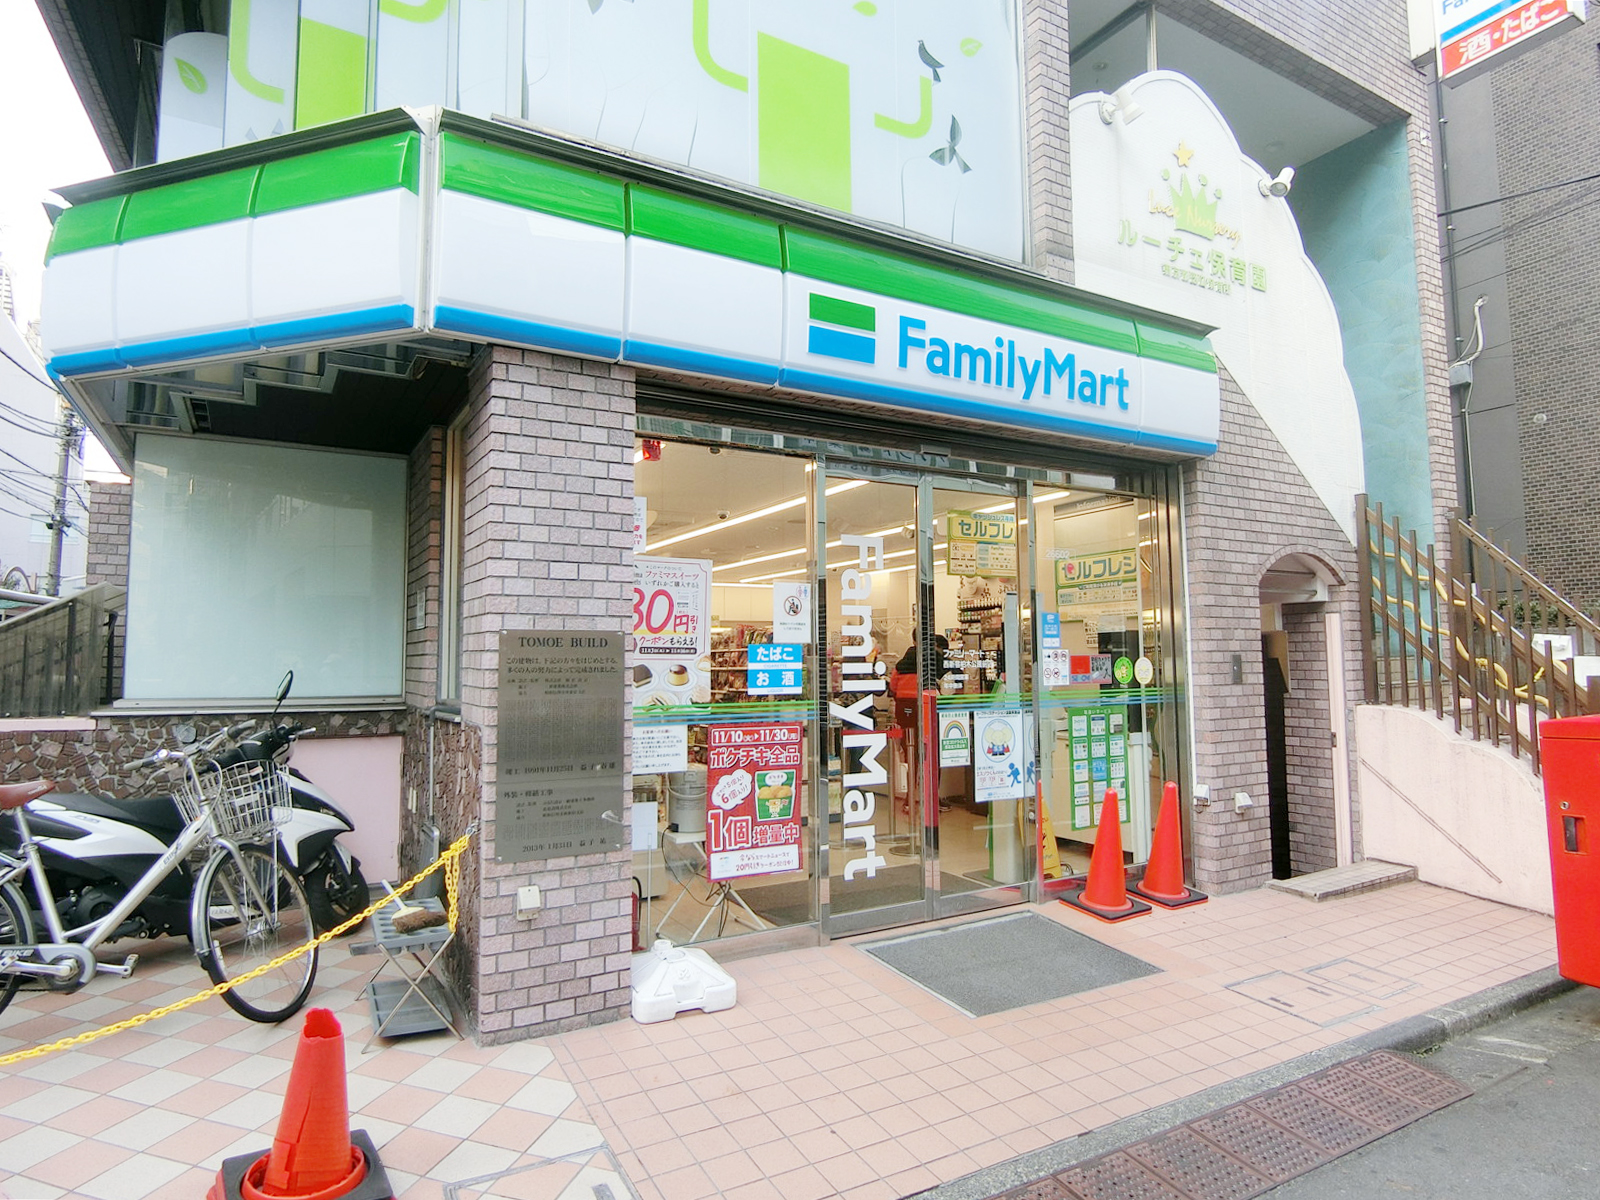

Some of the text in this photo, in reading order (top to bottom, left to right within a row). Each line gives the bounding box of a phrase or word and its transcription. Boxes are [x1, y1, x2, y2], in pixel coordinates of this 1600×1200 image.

[898, 315, 1130, 411] FamilyMart
[645, 571, 699, 580] ファミマスイーツ
[518, 637, 608, 648] TOMOE BUILD
[756, 646, 795, 662] たばこ
[829, 534, 887, 881] FamilyMart
[710, 745, 800, 768] ポケチキ全品
